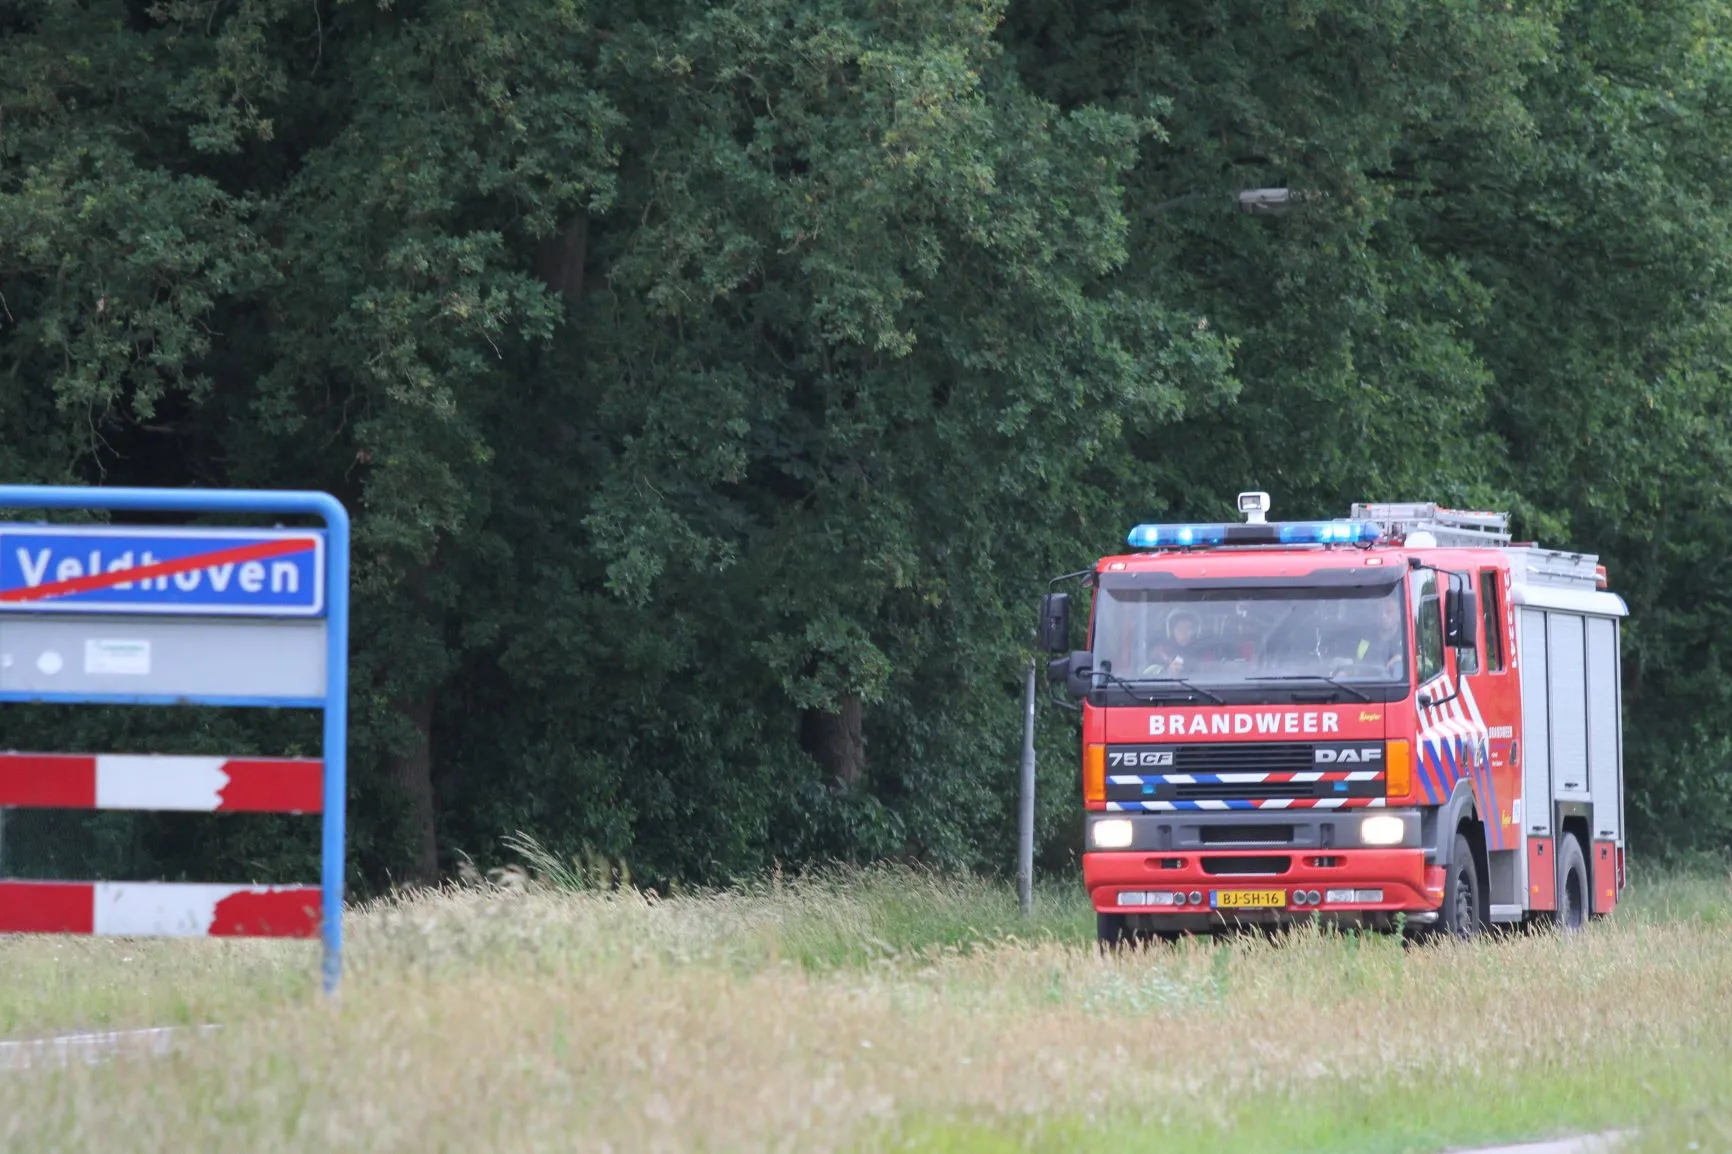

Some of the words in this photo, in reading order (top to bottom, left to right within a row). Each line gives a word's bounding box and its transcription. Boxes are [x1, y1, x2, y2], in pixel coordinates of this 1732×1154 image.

[16, 547, 299, 593] Veldhoven
[1148, 712, 1339, 736] BRANDWEER
[1109, 752, 1138, 767] 75
[1142, 753, 1173, 766] CF
[1314, 748, 1382, 764] DAF
[1223, 892, 1279, 906] BJ-SH-16
